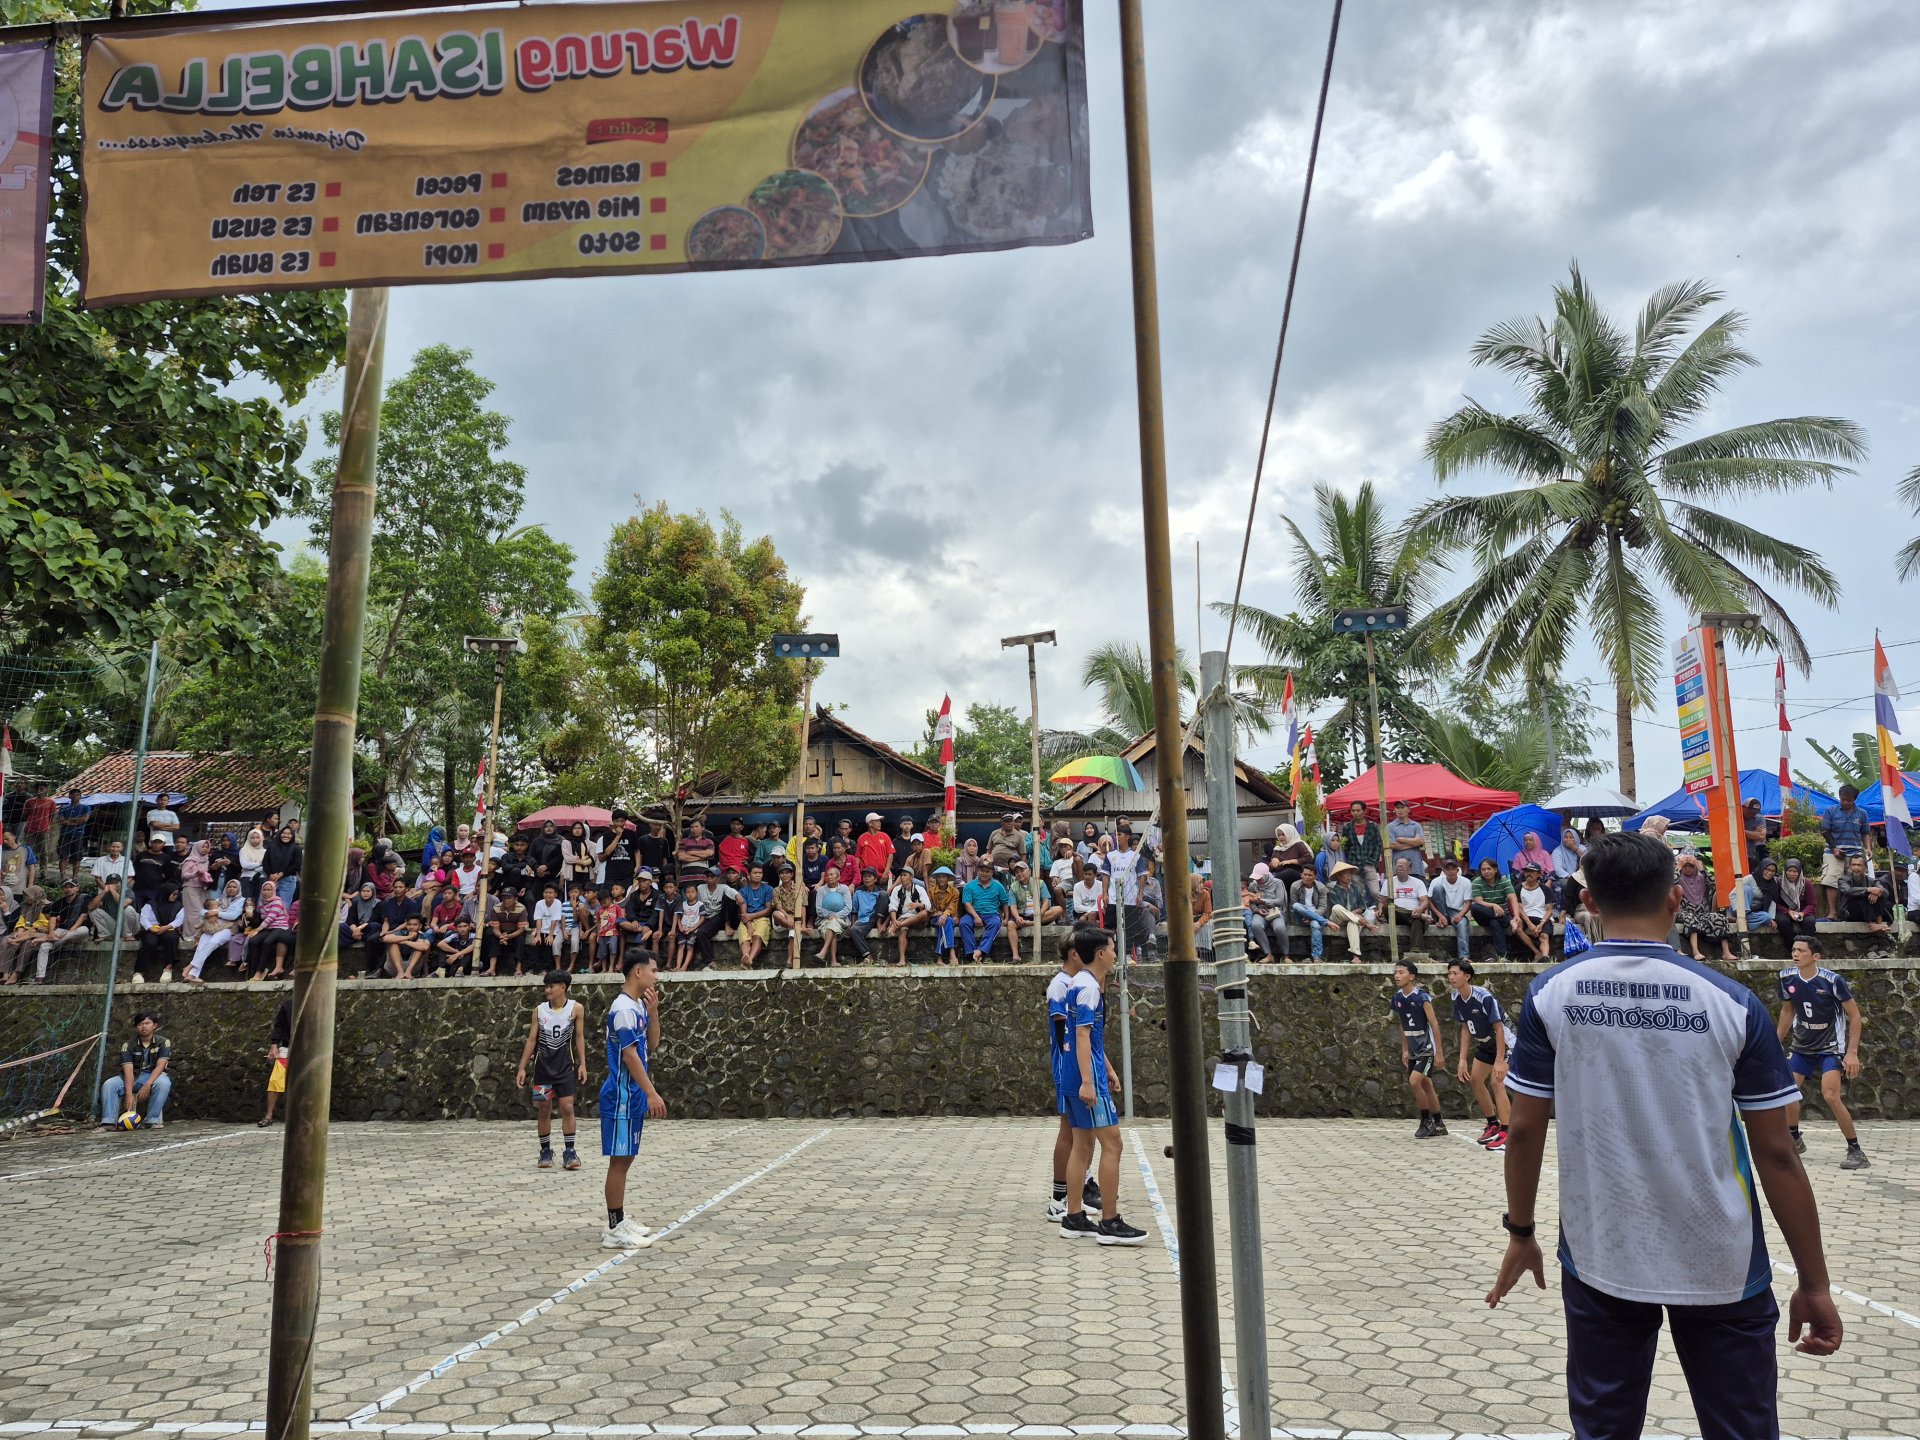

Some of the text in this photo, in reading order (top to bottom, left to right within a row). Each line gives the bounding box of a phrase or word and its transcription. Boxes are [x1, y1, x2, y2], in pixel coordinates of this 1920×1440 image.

[1576, 980, 1691, 1001] REFEREE BOLA VOLI
[1563, 1002, 1709, 1033] wonosobo
[1803, 1001, 1813, 1018] 6
[552, 1025, 561, 1039] 6
[1467, 1020, 1477, 1035] 8
